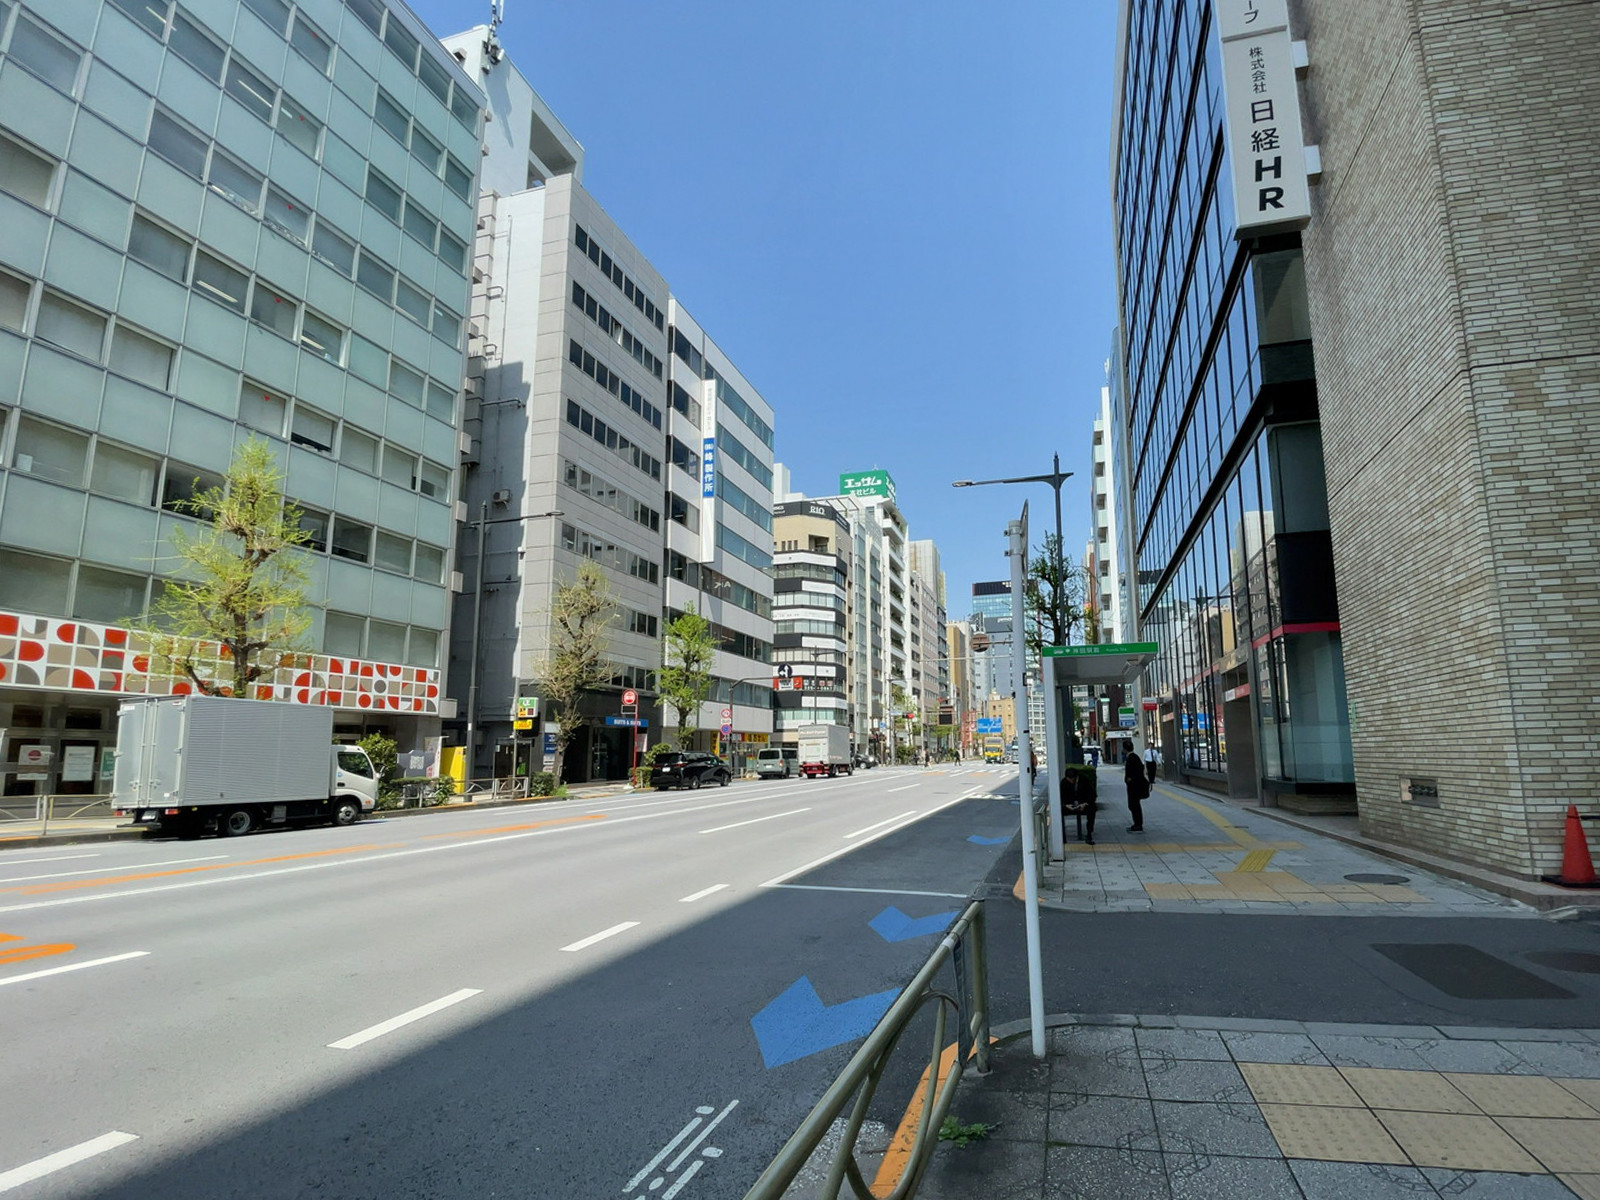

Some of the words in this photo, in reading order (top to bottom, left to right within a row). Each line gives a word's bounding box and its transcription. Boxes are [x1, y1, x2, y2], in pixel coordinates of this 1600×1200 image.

[1249, 46, 1267, 93] 株式会社
[1250, 98, 1285, 212] 日経HR
